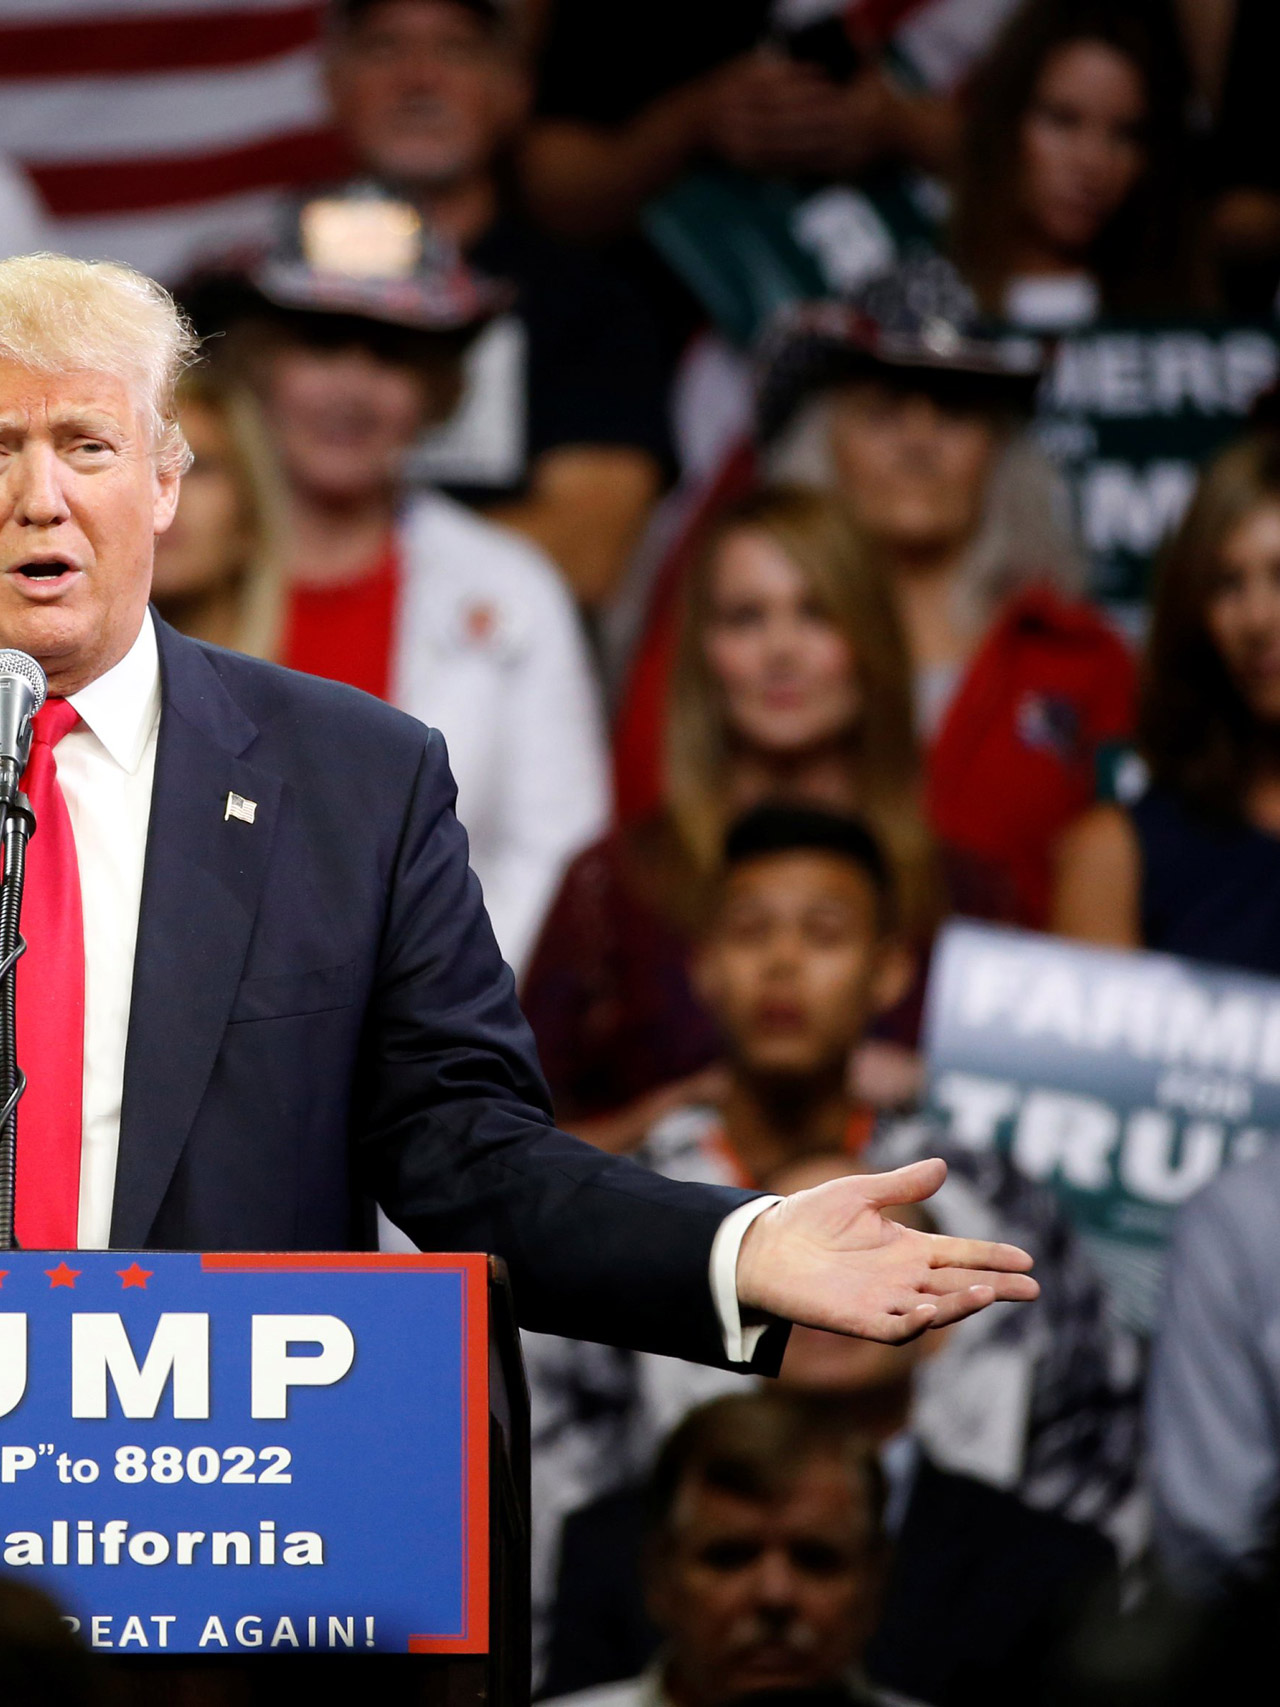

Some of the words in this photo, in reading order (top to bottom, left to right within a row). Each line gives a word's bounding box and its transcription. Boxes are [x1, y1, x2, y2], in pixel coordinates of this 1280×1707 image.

[56, 1455, 100, 1484] to
[114, 1446, 293, 1484] 88022
[198, 1615, 376, 1648] AGAIN!
